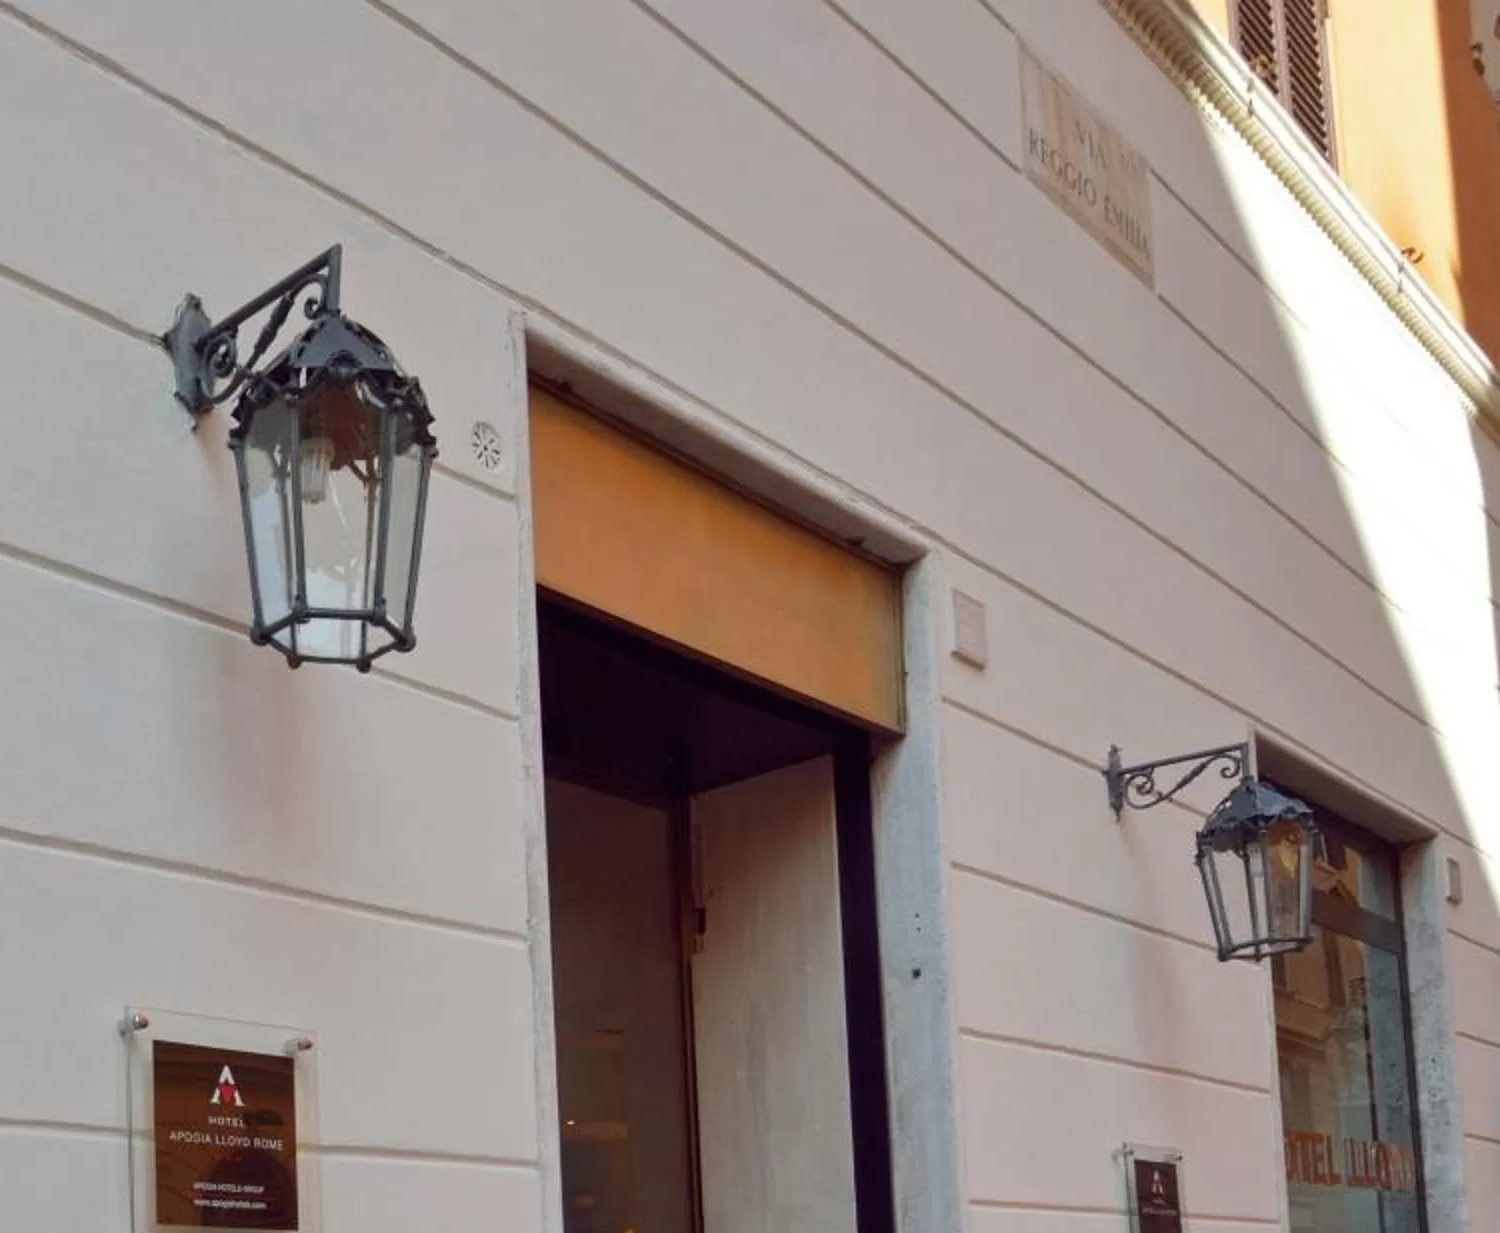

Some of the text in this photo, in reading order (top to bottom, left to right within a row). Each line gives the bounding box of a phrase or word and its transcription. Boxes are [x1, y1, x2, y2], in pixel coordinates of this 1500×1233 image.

[1075, 119, 1109, 169] VIA
[1028, 126, 1097, 207] REGGIO
[208, 1115, 246, 1128] HOTEL
[169, 1129, 284, 1151] APOGIA LLOYD ROME
